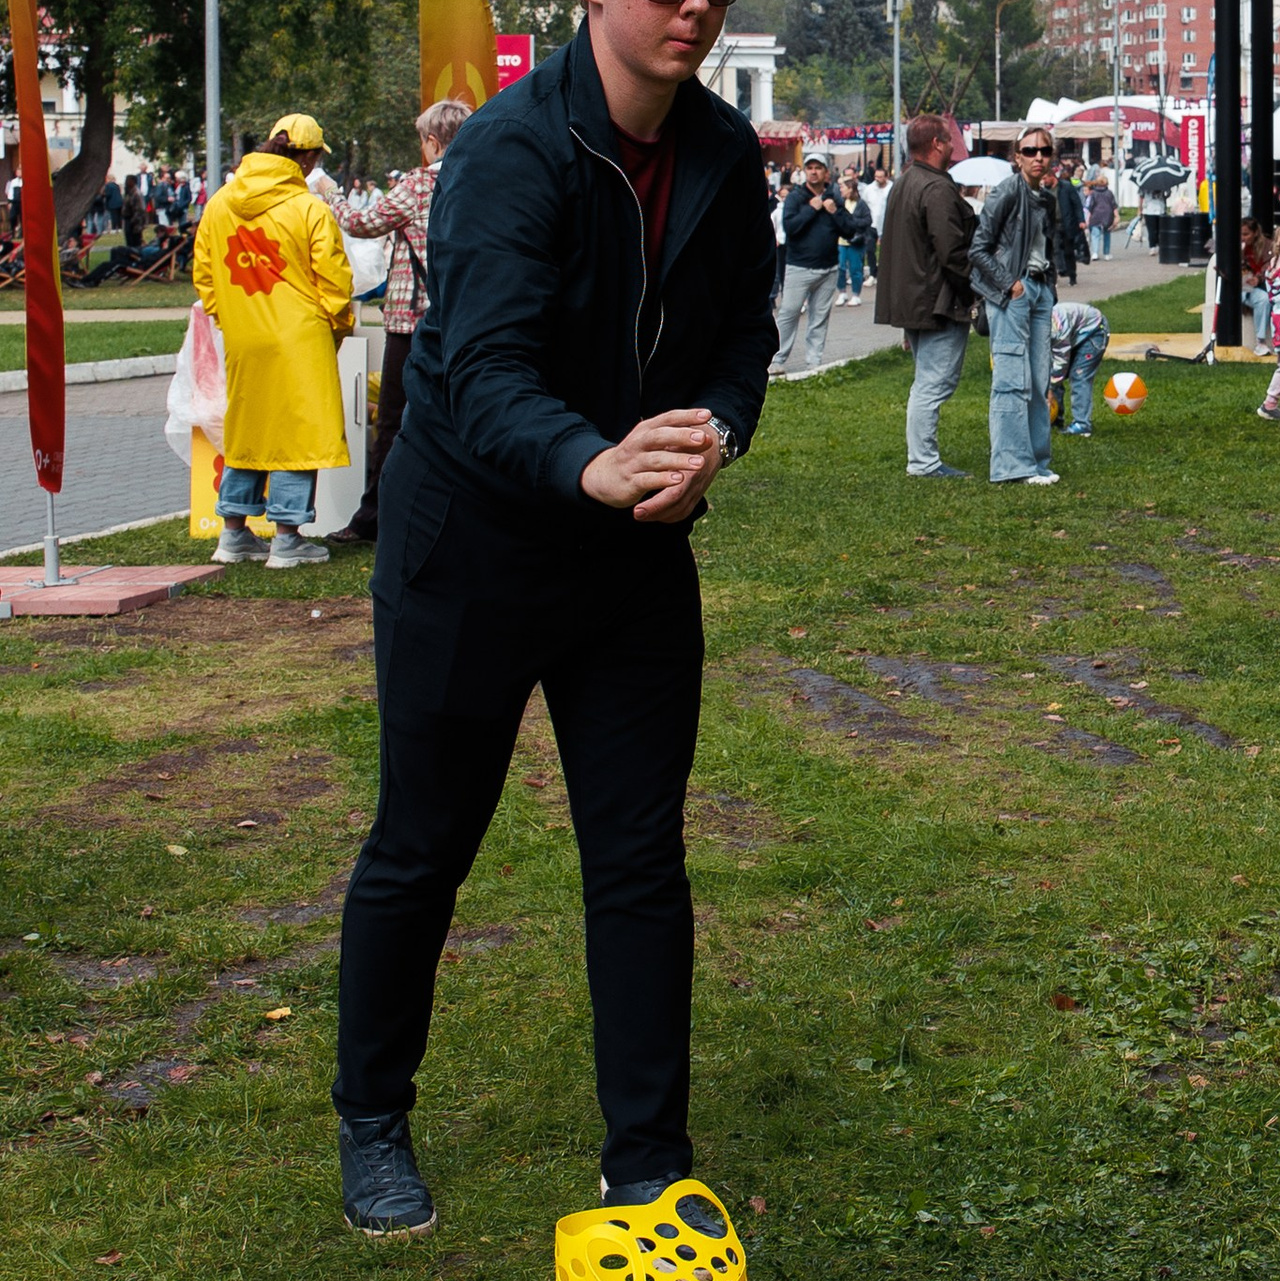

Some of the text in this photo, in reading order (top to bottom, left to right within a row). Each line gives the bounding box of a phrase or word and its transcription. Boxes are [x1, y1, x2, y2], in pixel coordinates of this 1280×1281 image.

[496, 54, 522, 67] ЕТО
[1188, 118, 1199, 171] НОЛЕТО
[35, 449, 50, 471] 0+
[199, 517, 217, 530] 0+
